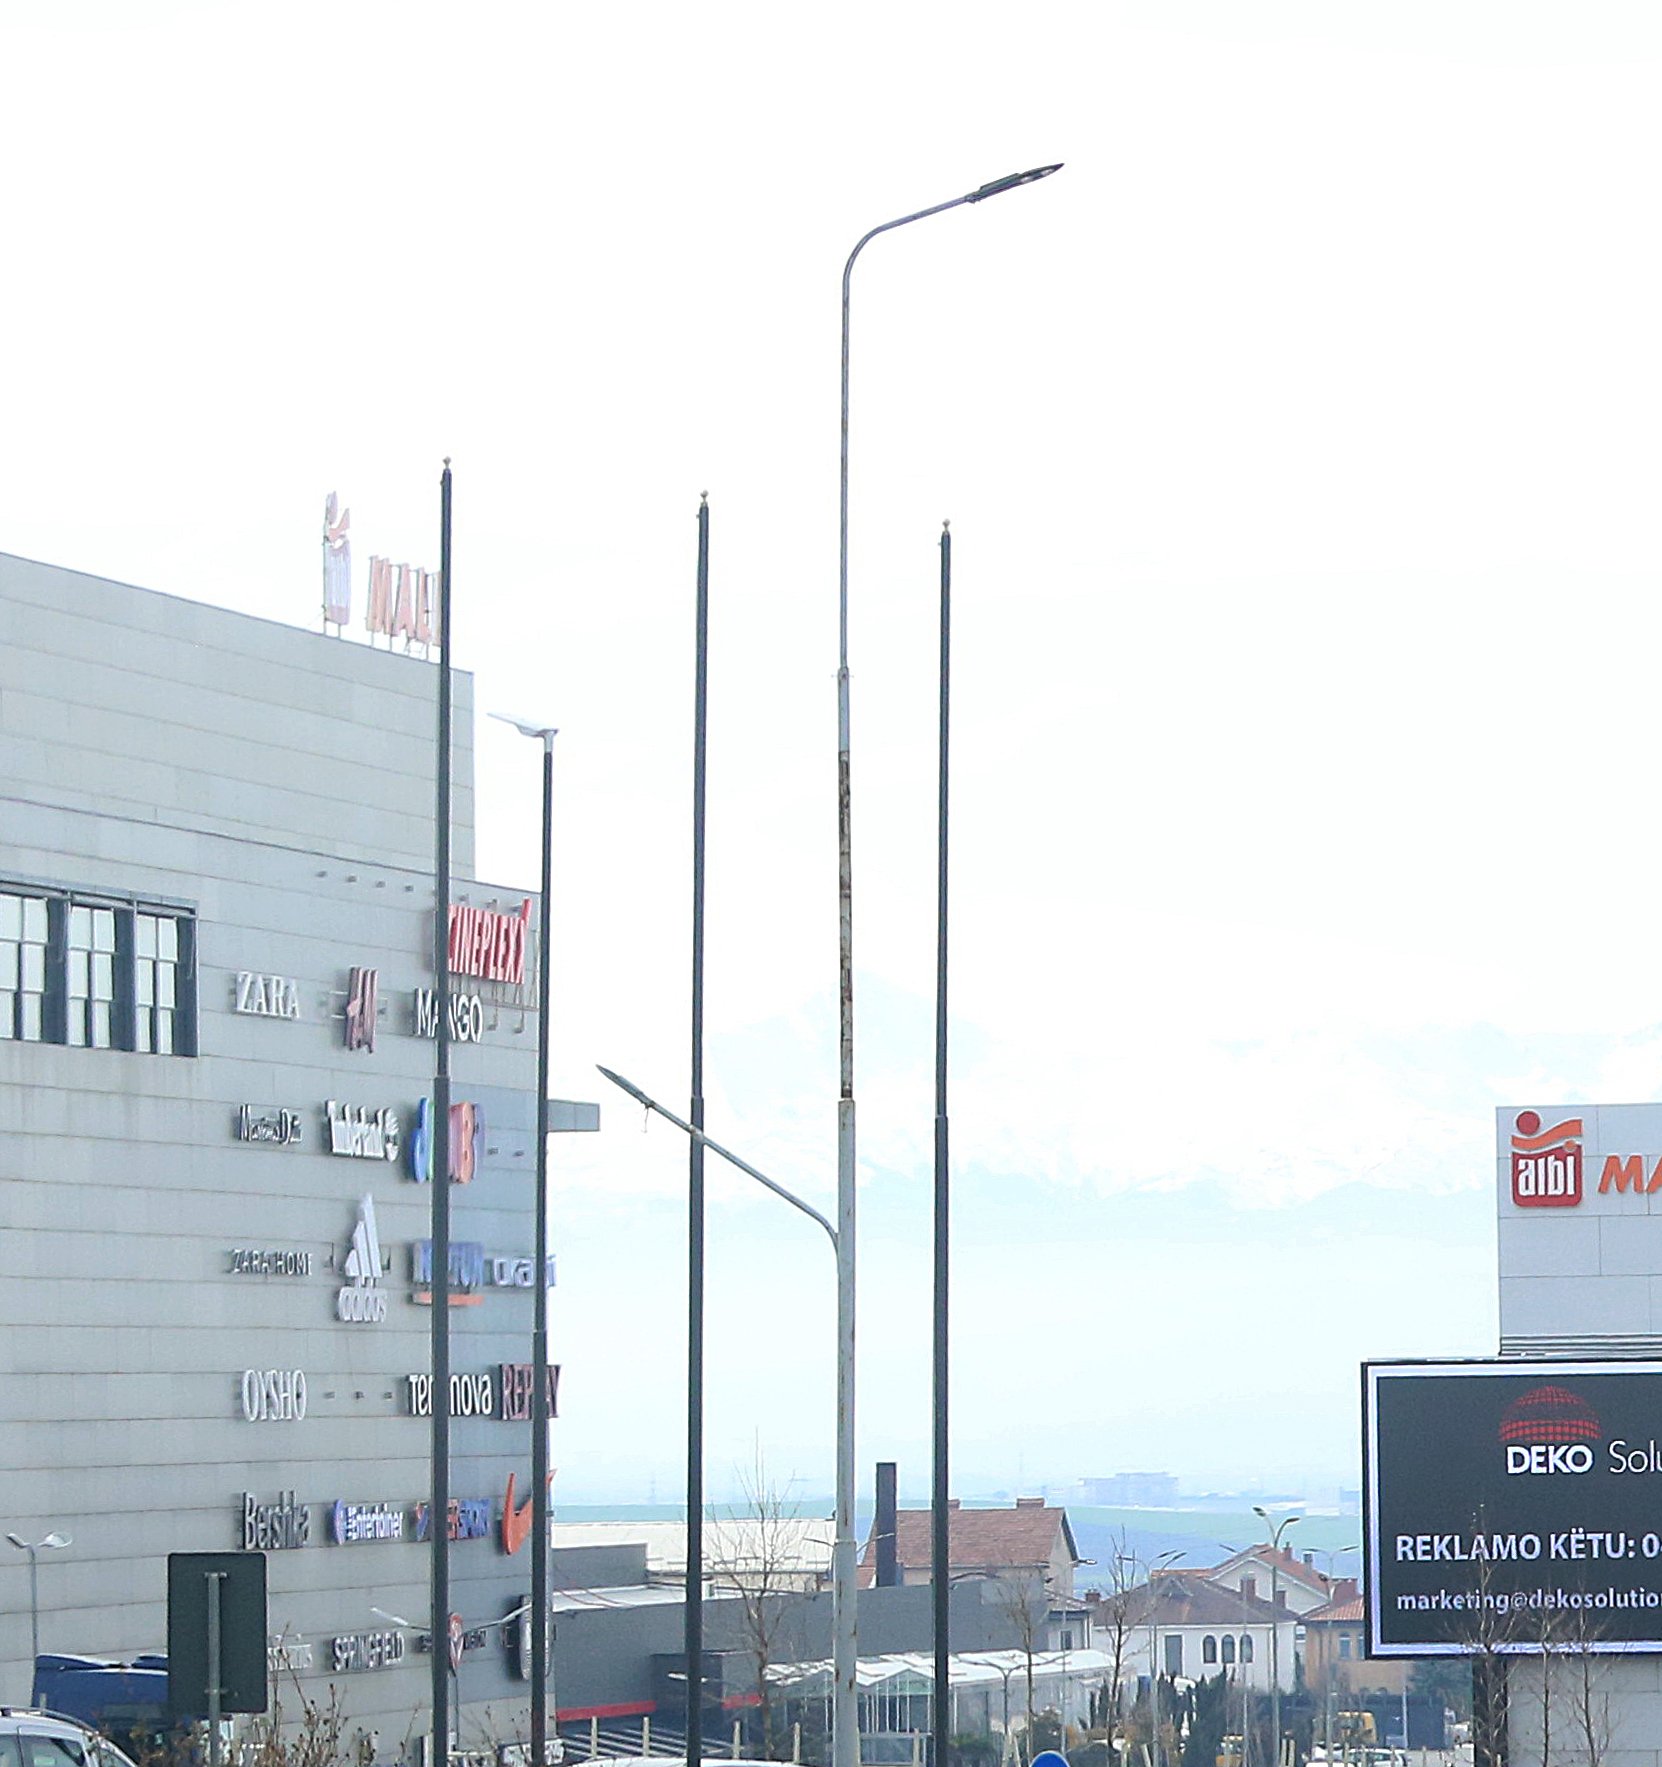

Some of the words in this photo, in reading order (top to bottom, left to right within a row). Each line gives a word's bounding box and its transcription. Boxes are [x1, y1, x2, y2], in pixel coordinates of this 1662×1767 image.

[236, 971, 300, 1019] ZARA
[415, 988, 484, 1042] MNGO
[1517, 1154, 1576, 1196] albi
[242, 1369, 307, 1422] OYSHO
[409, 1374, 493, 1417] Ternova
[499, 1364, 561, 1420] REPY
[1506, 1445, 1595, 1474] DEKO
[1396, 1533, 1541, 1562] REKLAMO
[1550, 1528, 1635, 1561] KËTU:
